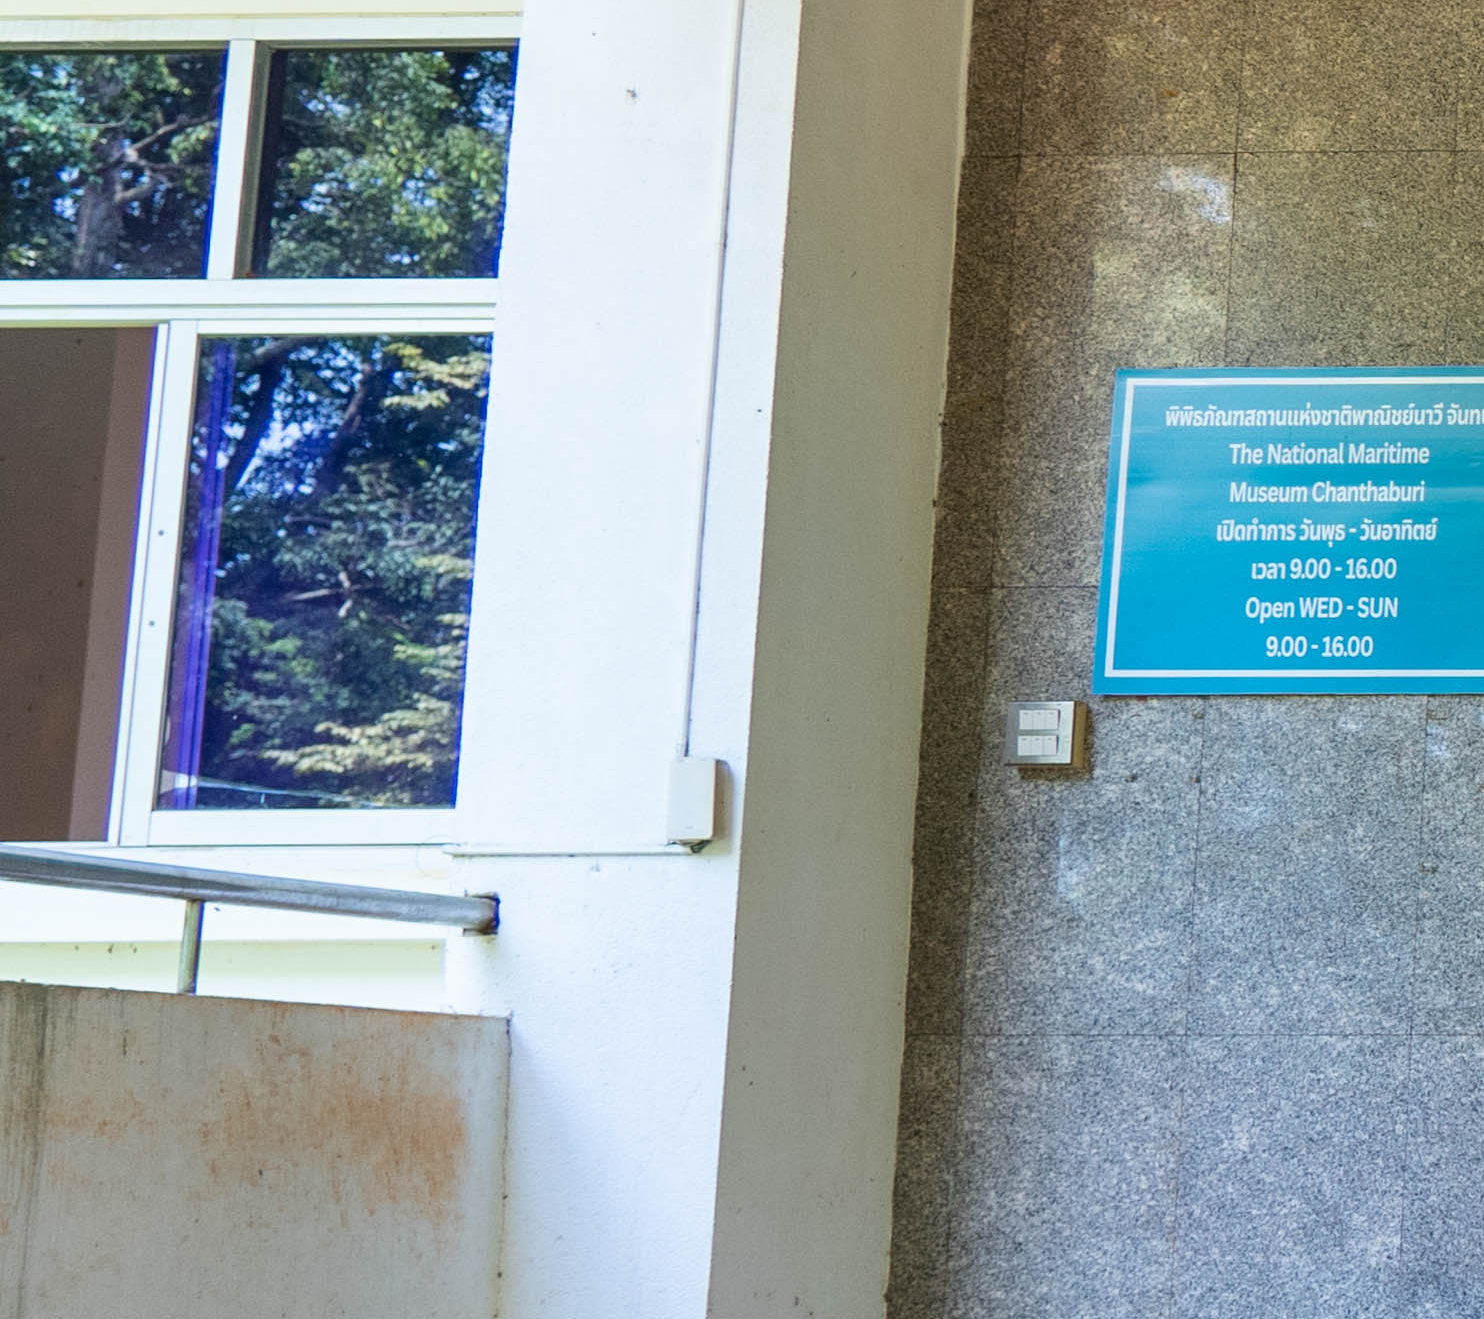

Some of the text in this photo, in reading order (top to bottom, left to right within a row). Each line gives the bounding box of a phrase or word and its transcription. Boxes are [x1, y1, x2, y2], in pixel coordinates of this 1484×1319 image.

[1165, 402, 1444, 426] พิพิธภัณฑสถานแห่งชาติพาณิชย์นาวี
[1229, 442, 1430, 464] The National Maritime
[1229, 481, 1425, 503] Museum Chanthaburi
[1216, 518, 1296, 541] เปิดทำการ
[1299, 519, 1346, 548] วันพุธ
[1359, 518, 1438, 541] วันอาทิตย์
[1251, 562, 1286, 579] เวลา
[1290, 558, 1331, 579] 9.00
[1345, 558, 1397, 579] 16.00
[1245, 596, 1295, 624] Open
[1299, 597, 1343, 618] WED
[1357, 596, 1399, 618] SUN
[1265, 635, 1308, 657] 9.00
[1322, 635, 1374, 657] 16.00
